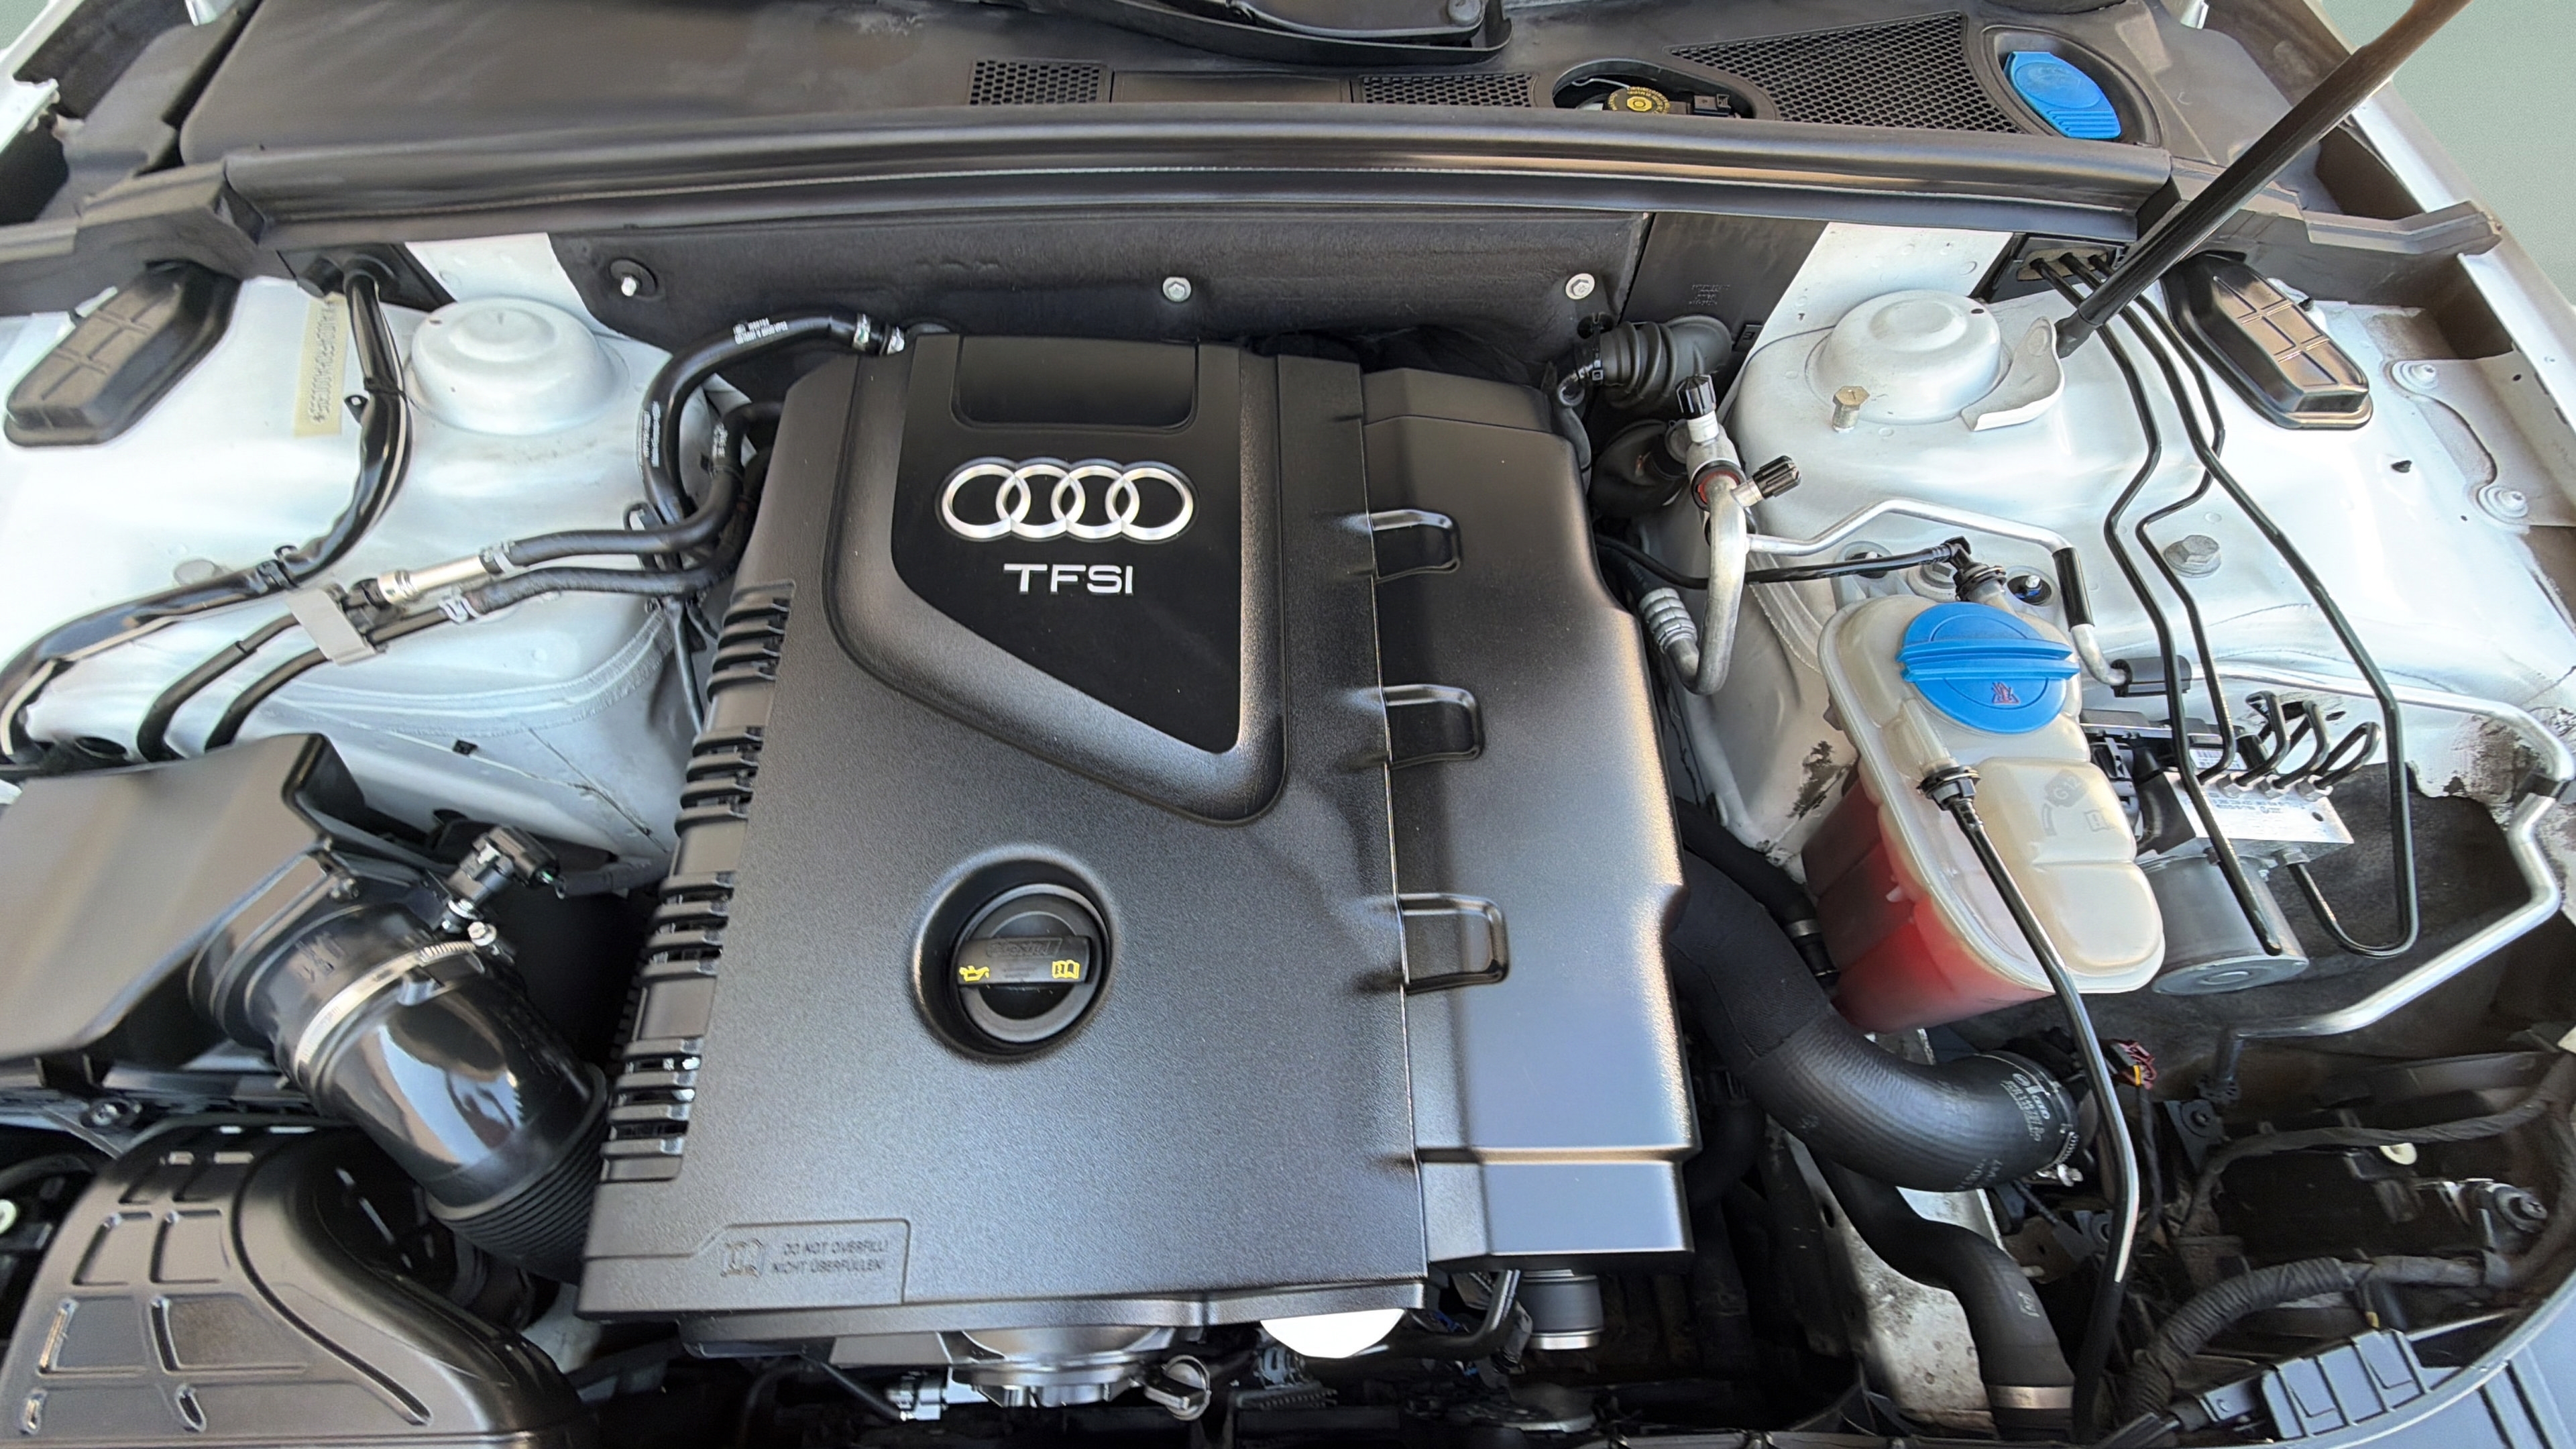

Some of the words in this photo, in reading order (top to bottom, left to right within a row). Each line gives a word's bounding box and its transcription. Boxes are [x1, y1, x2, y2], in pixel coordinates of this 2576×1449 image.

[1003, 563, 1134, 595] TFSI
[2053, 775, 2082, 800] G12
[783, 1242, 801, 1256] DO
[805, 1241, 828, 1255] NOT
[773, 1260, 806, 1275] NICHT
